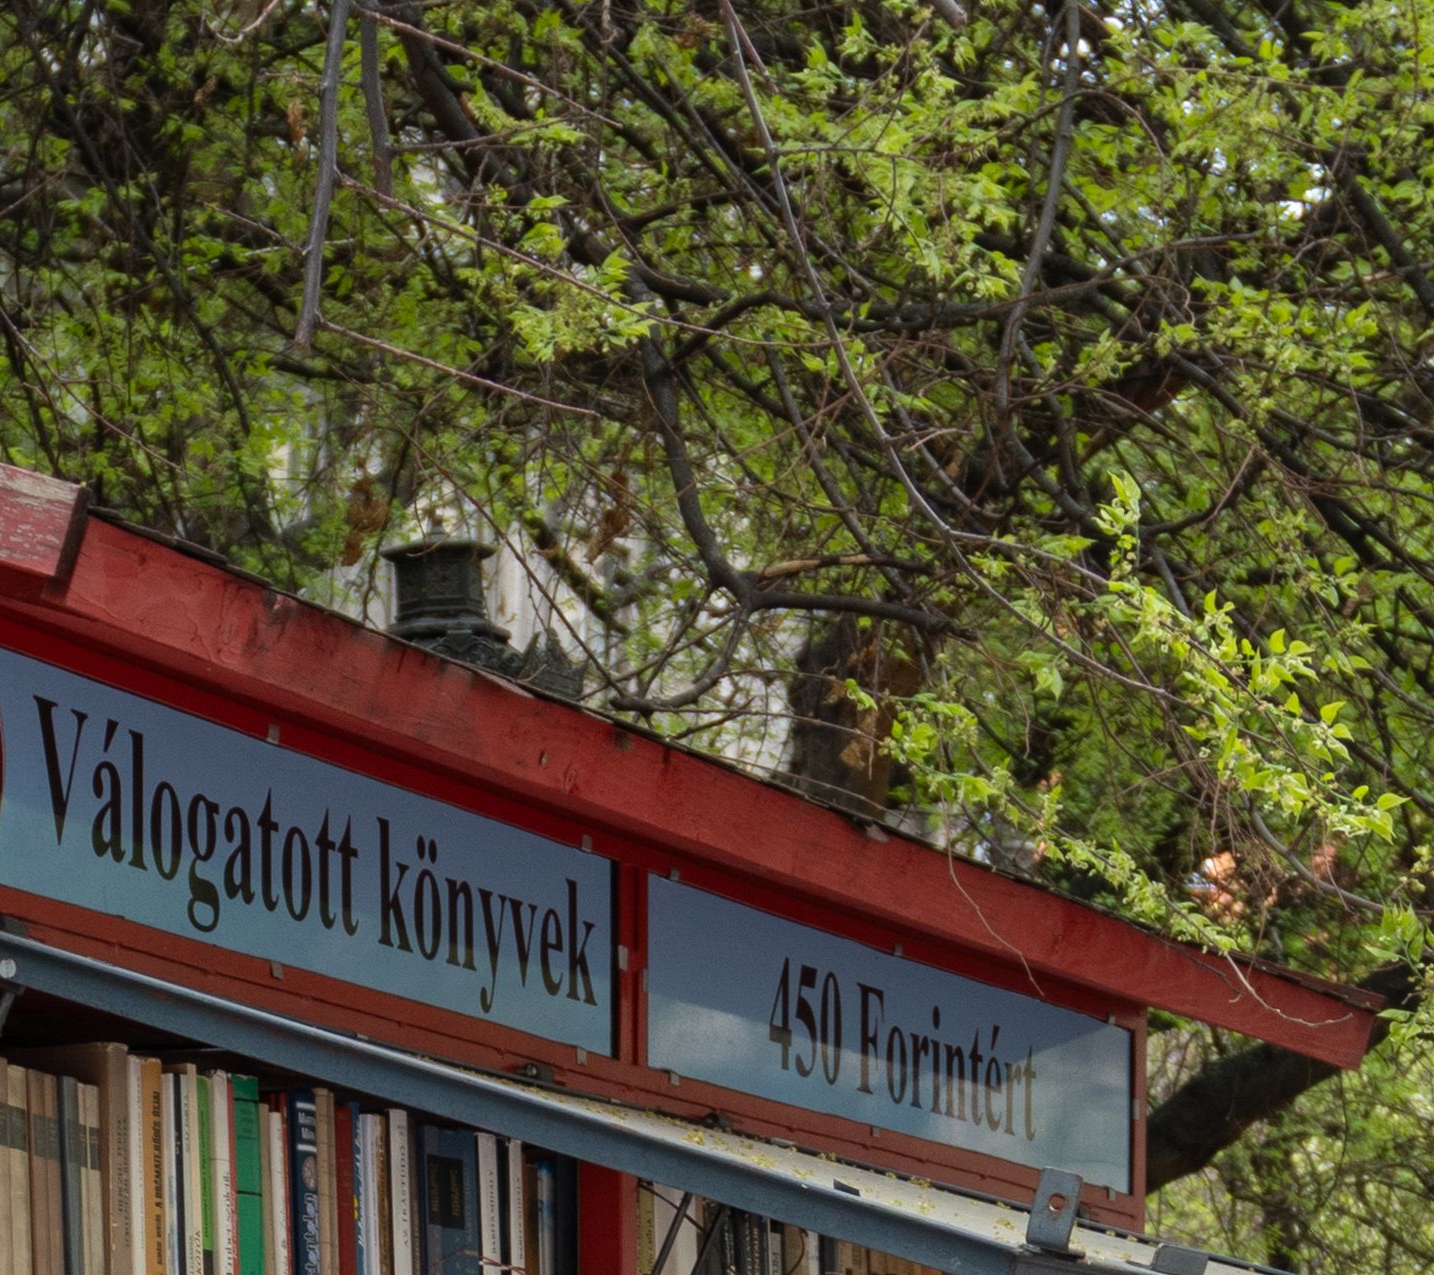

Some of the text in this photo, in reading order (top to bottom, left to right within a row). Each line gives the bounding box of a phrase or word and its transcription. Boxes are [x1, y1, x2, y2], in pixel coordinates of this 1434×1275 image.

[34, 695, 598, 1012] Válogatott könyvek
[770, 955, 1037, 1141] 450 Forintért
